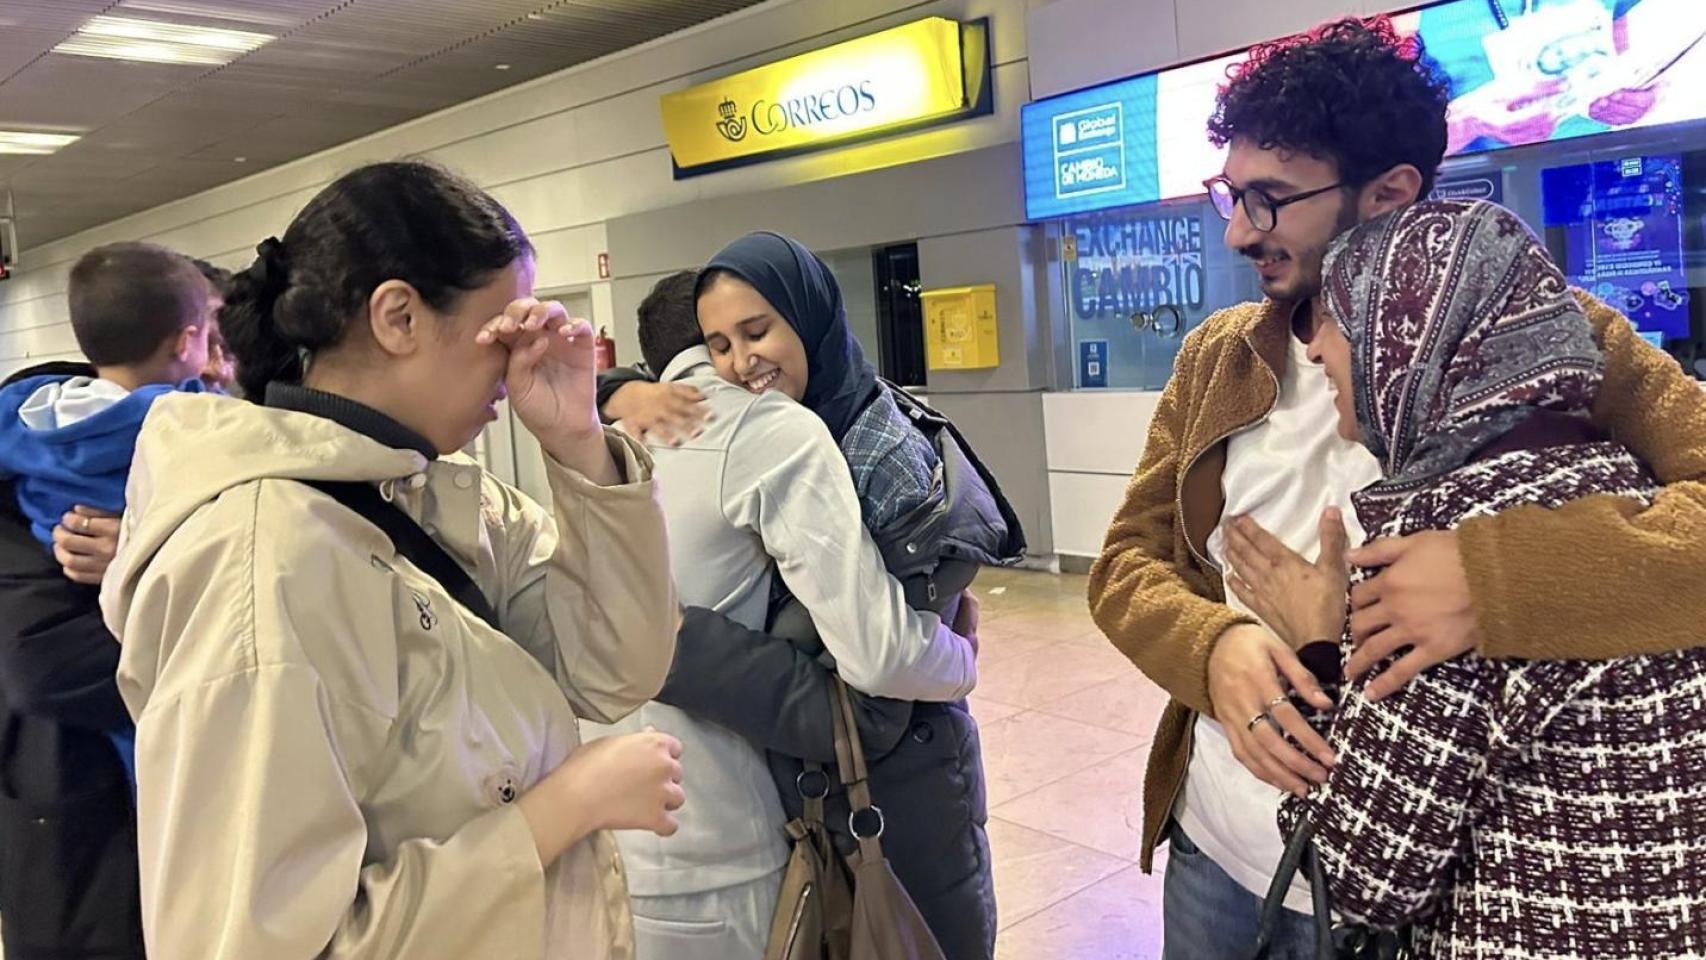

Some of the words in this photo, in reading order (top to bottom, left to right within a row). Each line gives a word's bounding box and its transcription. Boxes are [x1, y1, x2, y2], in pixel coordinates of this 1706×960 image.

[751, 80, 875, 135] CORREOS
[1078, 114, 1116, 132] Global
[1061, 157, 1104, 176] CAMBIO
[1062, 174, 1075, 186] DE
[1076, 166, 1118, 183] MONEDA
[1072, 216, 1201, 257] EXCHANGE
[1074, 261, 1205, 320] CAMBIO
